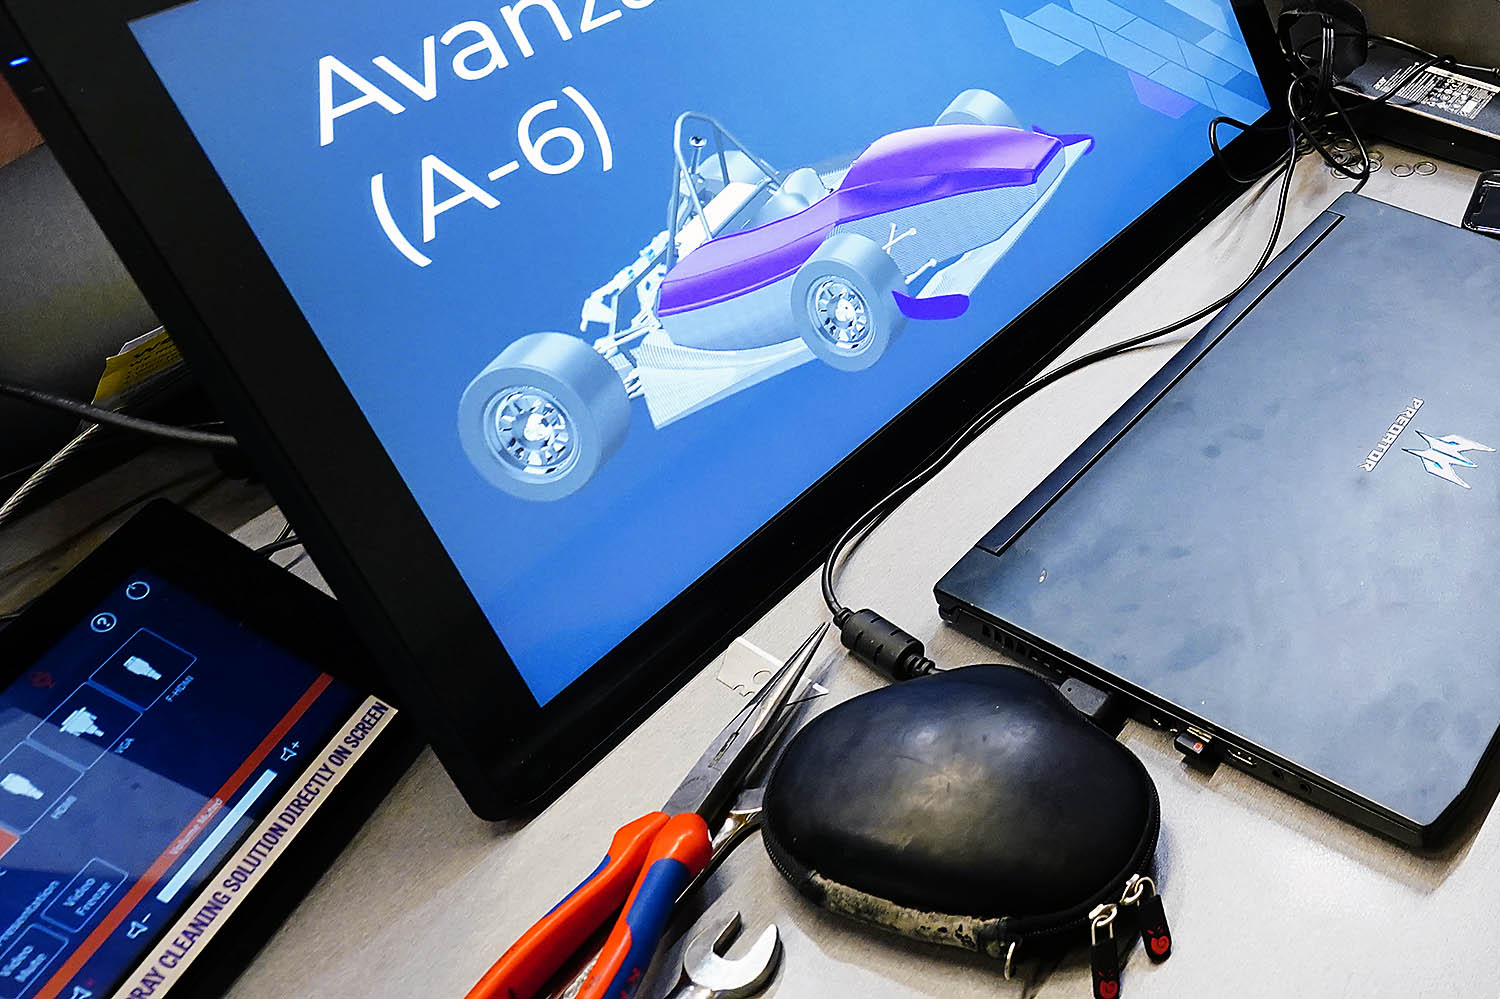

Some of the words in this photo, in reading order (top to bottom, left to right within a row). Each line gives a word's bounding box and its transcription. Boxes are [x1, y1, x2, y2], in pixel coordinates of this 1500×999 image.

[371, 86, 614, 268] (A-6)
[1359, 397, 1424, 473] PREDATOR
[0, 880, 61, 946] resentation
[126, 966, 165, 999] RAY
[159, 891, 232, 969] CLEANING
[223, 822, 289, 893] SOLUTION
[278, 763, 336, 827] DIRECTLY
[327, 744, 353, 768] ON
[343, 701, 390, 749] SCREEN
